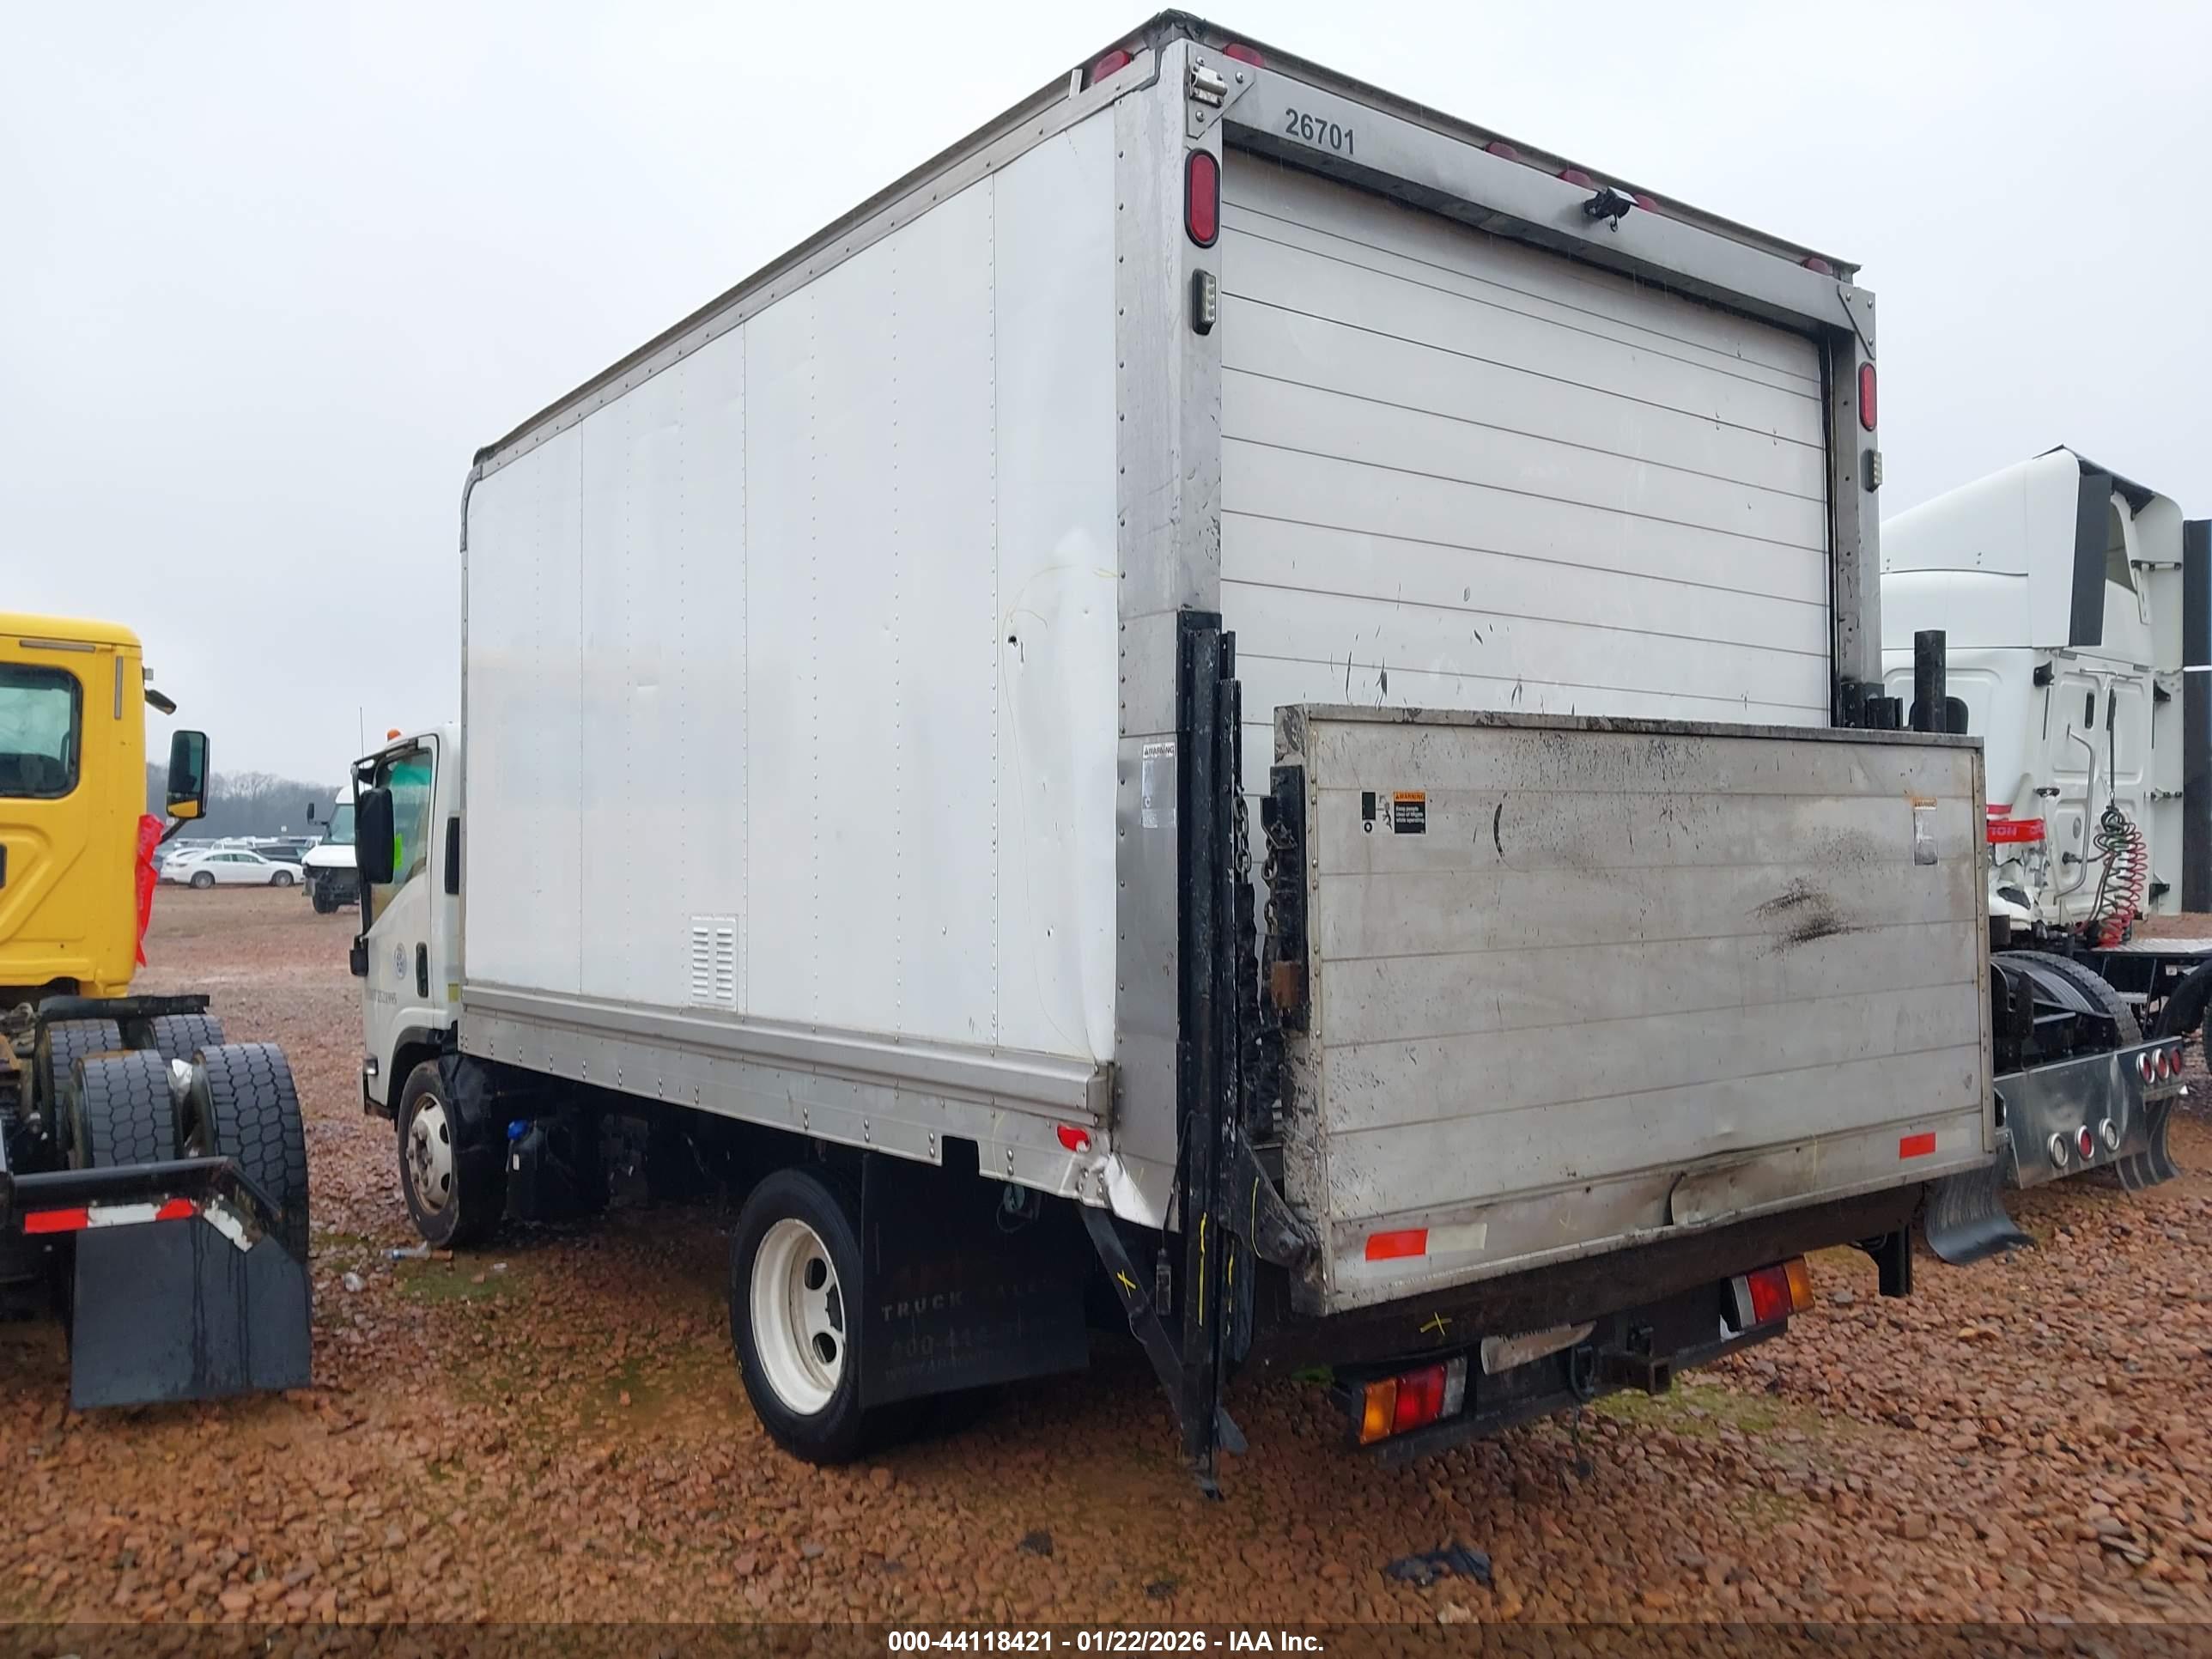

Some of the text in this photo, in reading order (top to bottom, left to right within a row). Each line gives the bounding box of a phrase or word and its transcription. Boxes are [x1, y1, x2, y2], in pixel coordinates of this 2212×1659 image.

[1285, 108, 1354, 155] 26701
[1149, 745, 1174, 756] WARNING
[881, 1291, 964, 1322] TRUCK
